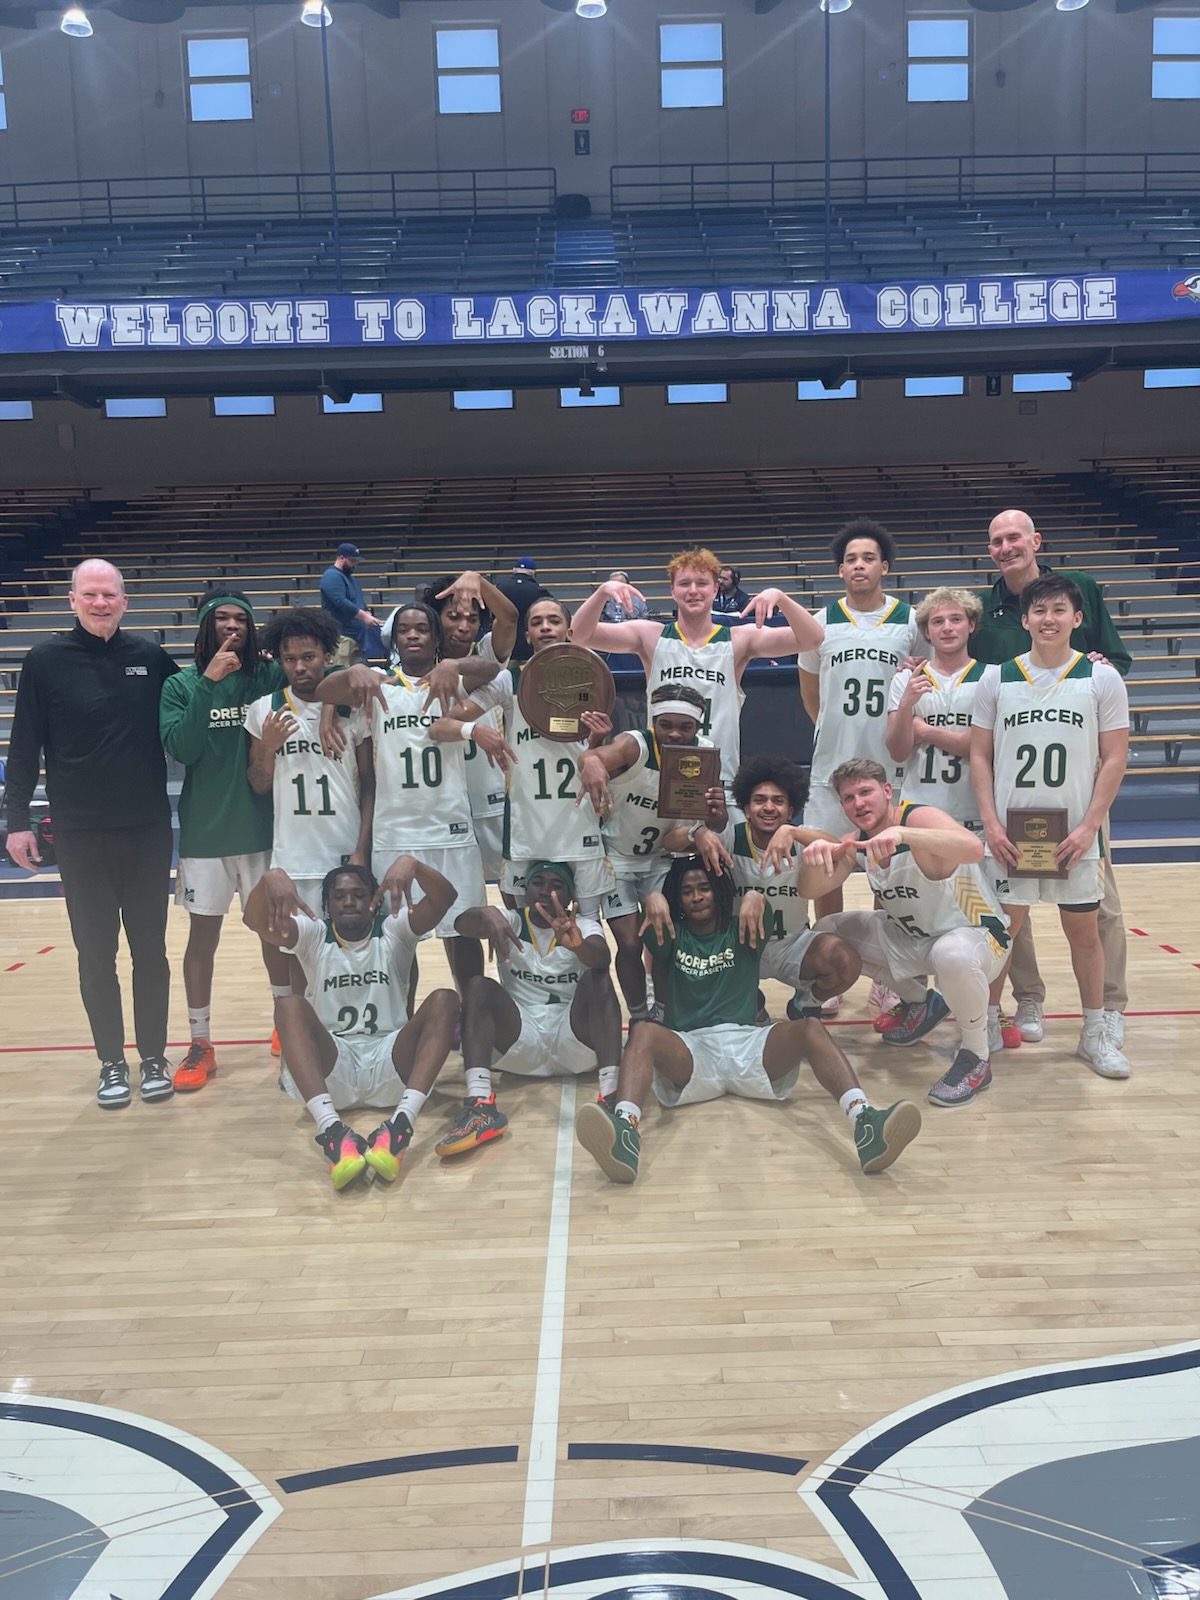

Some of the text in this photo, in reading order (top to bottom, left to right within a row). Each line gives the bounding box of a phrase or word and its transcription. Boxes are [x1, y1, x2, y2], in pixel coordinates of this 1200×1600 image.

[56, 277, 1117, 347] WELCOME TO LACKAWANNA COLLEGE
[550, 344, 605, 359] SECTION 6
[831, 648, 899, 667] MERCER
[660, 666, 726, 686] MERCER
[843, 678, 885, 718] 35
[210, 707, 239, 720] ORE
[384, 715, 441, 734] MERC
[924, 713, 972, 727] ERCE
[1004, 709, 1084, 731] MERCER
[400, 746, 443, 789] 10
[920, 744, 962, 784] 13
[1016, 743, 1067, 788] 20
[533, 758, 577, 800] 12
[292, 774, 336, 815] 11
[633, 827, 660, 855] 3
[874, 886, 920, 901] RCER
[676, 948, 734, 970] MORE RES
[324, 970, 390, 992] MERCER
[510, 969, 579, 985] MERCER
[332, 1003, 378, 1037] 23
